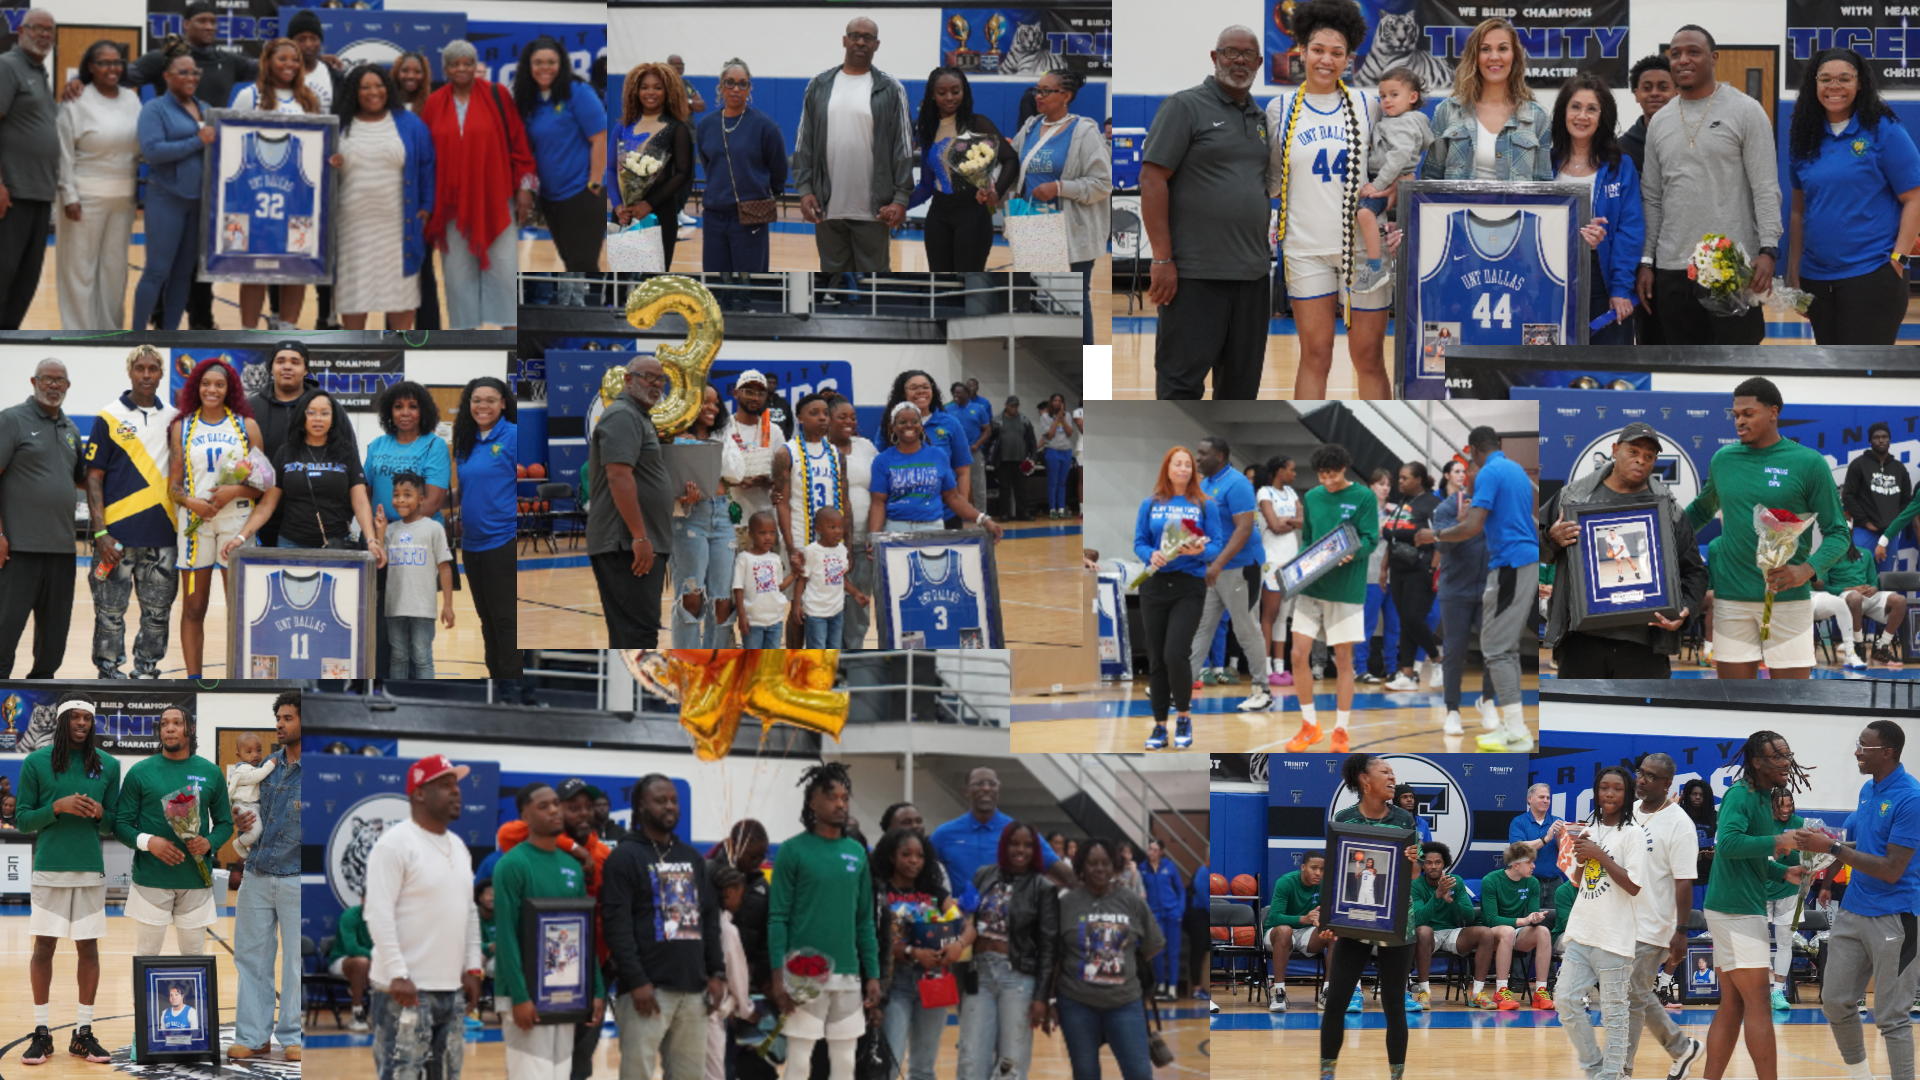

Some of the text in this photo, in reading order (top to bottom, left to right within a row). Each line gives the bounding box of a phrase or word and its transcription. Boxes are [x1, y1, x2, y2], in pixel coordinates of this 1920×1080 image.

[1458, 7, 1592, 18] WE BUILD CHAMPIONS
[1840, 6, 1873, 16] WITH
[1297, 127, 1317, 146] UNT
[1312, 148, 1348, 183] 44
[255, 192, 284, 219] 32
[1460, 268, 1525, 291] UNT DALLAS
[1472, 292, 1512, 329] 44
[335, 360, 381, 368] CHAMPIONS
[208, 432, 239, 446] DALLAS
[85, 442, 98, 461] 3
[814, 483, 826, 507] 3
[293, 615, 327, 633] DALLAS
[933, 605, 948, 630] 3
[290, 633, 310, 660] 11
[102, 740, 113, 748] OF
